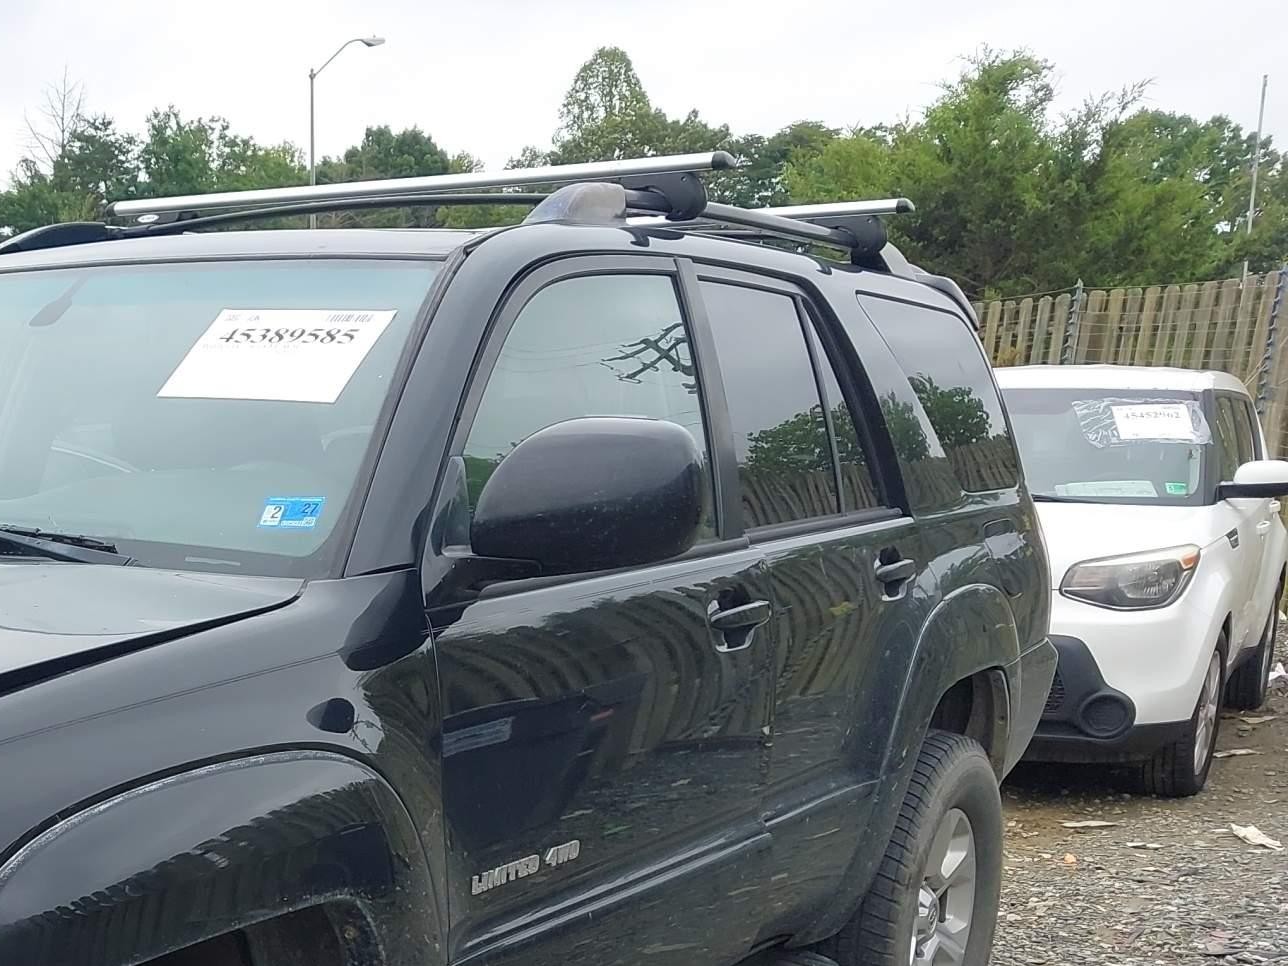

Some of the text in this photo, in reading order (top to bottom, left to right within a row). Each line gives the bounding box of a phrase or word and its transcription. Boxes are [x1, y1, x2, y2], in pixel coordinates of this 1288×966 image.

[218, 327, 361, 345] 45389585
[270, 503, 320, 519] 2 27
[471, 839, 581, 896] LIMITED 4WD
